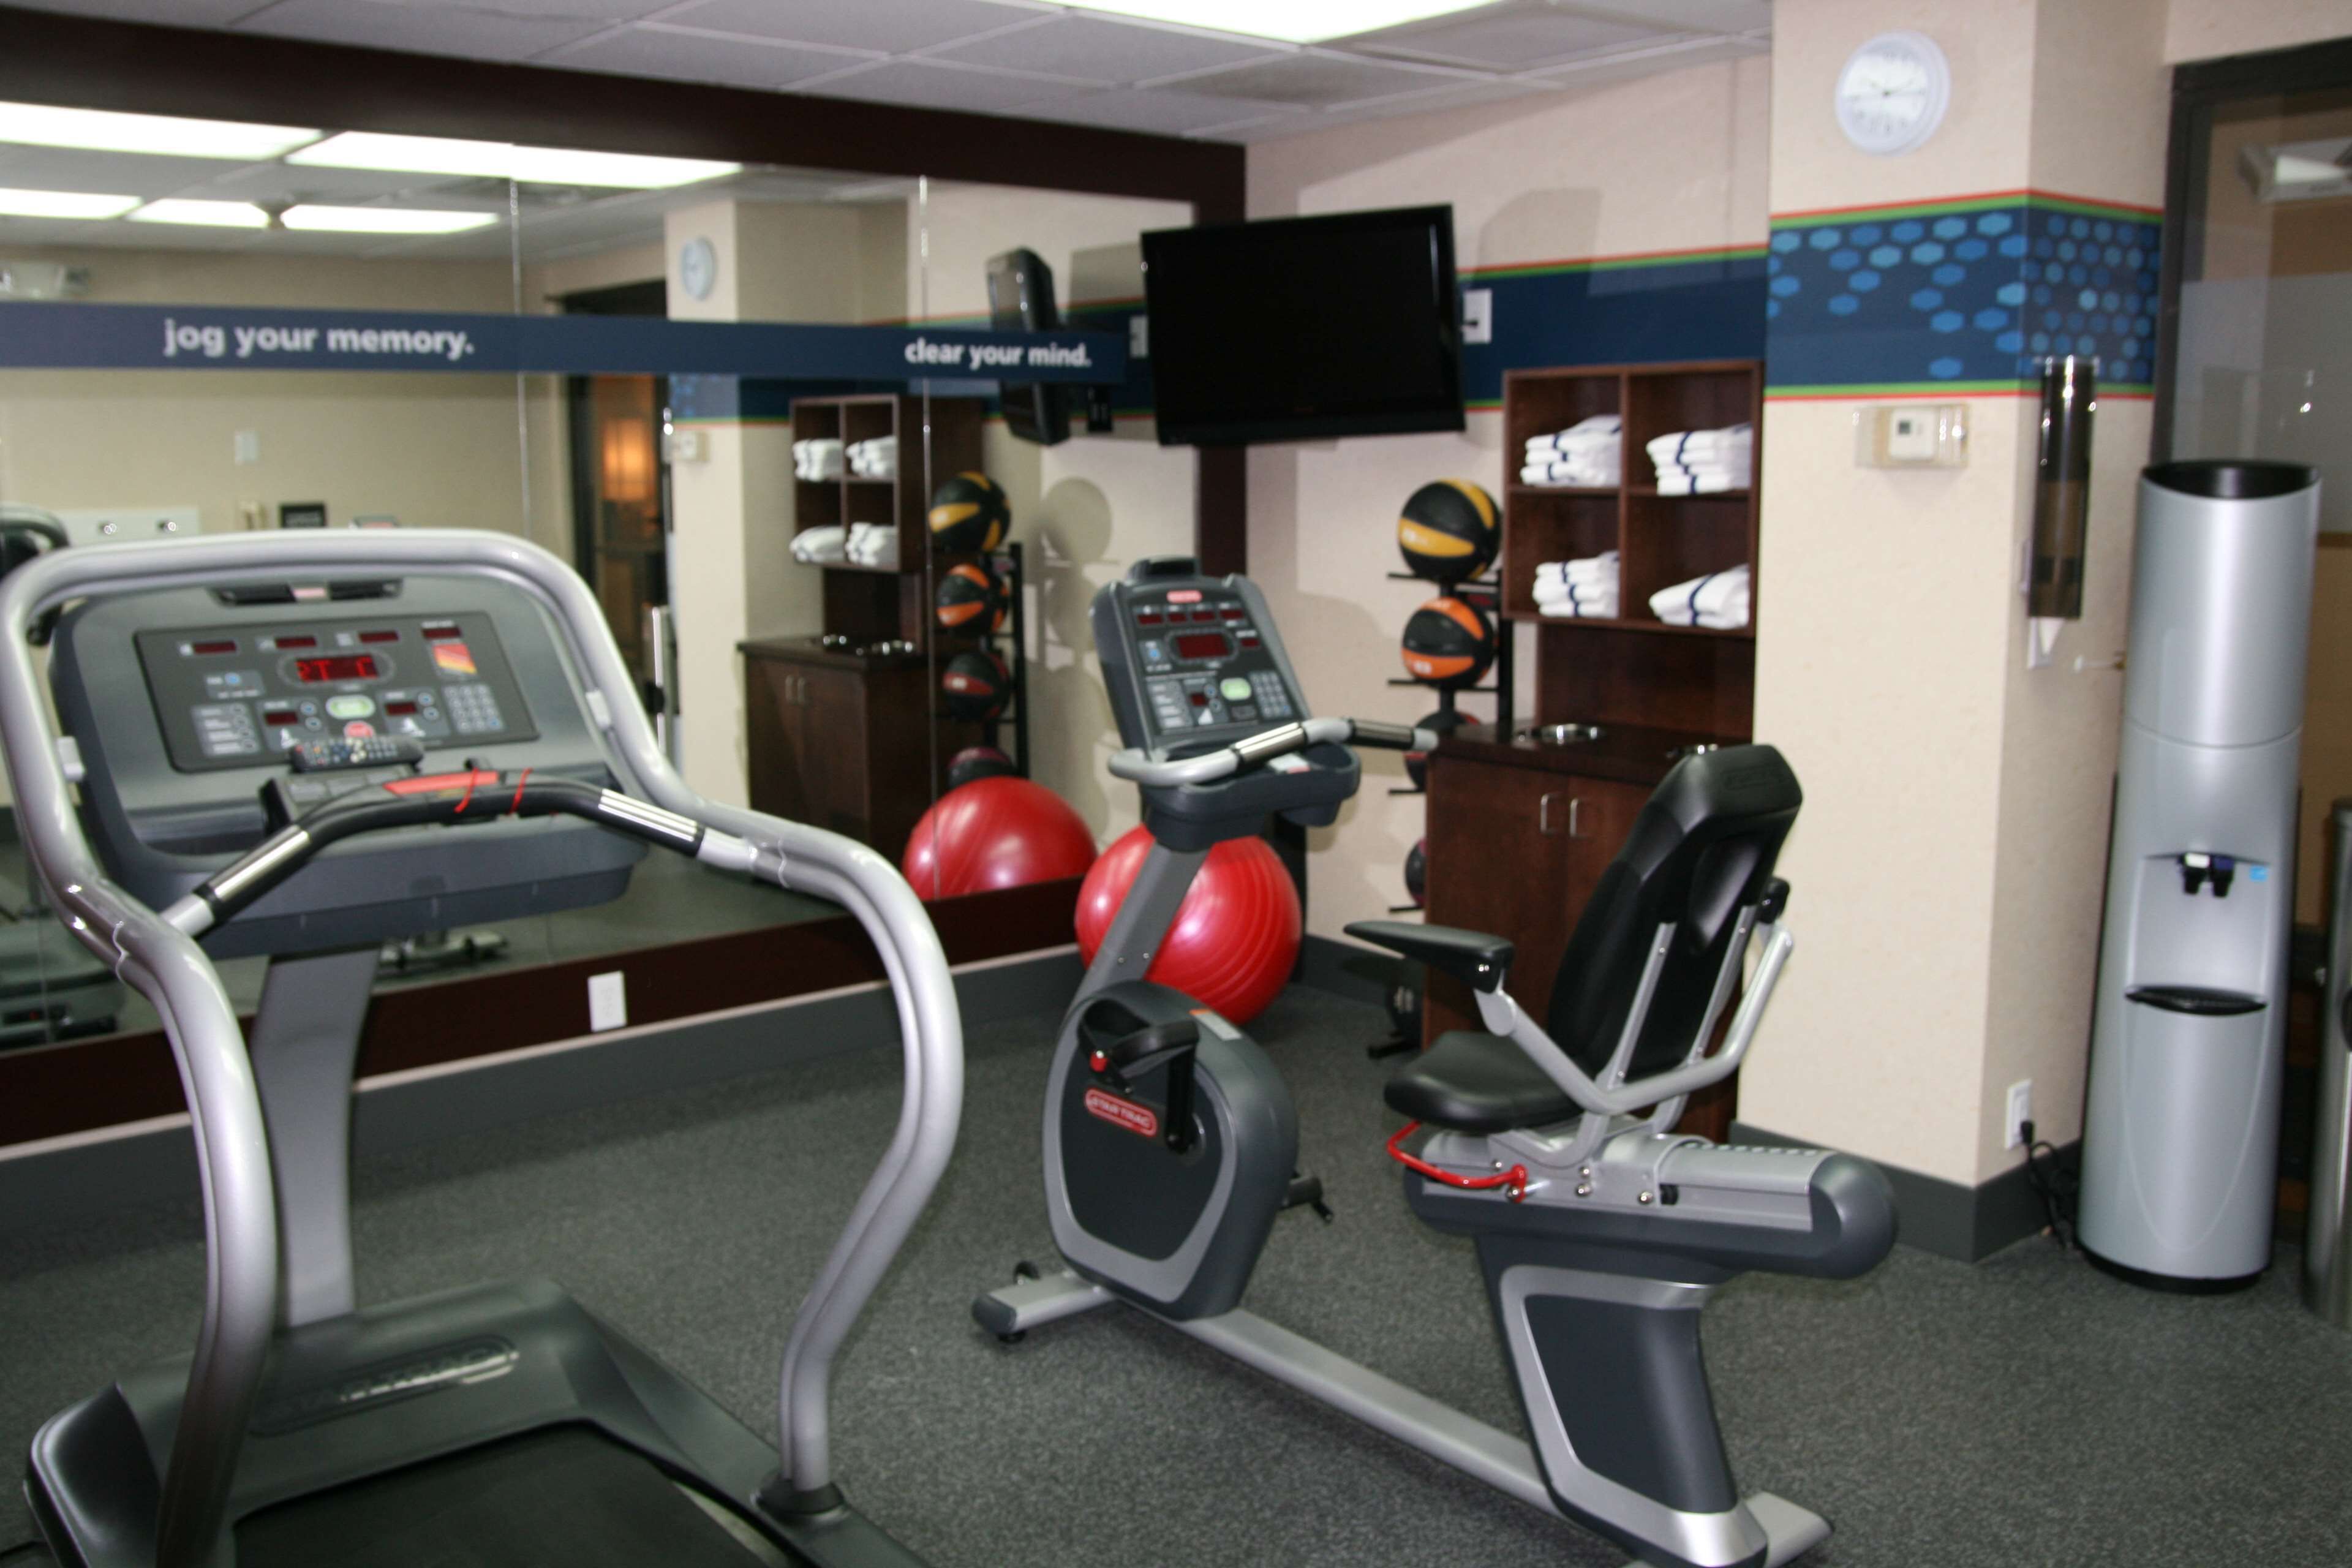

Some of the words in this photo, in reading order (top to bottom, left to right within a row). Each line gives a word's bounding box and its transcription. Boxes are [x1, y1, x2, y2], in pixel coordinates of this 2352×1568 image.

[163, 317, 225, 358] jog
[234, 326, 318, 358] your
[326, 328, 473, 361] memory.
[903, 336, 965, 364] clear
[968, 344, 1023, 370] your
[1027, 342, 1091, 367] mind.
